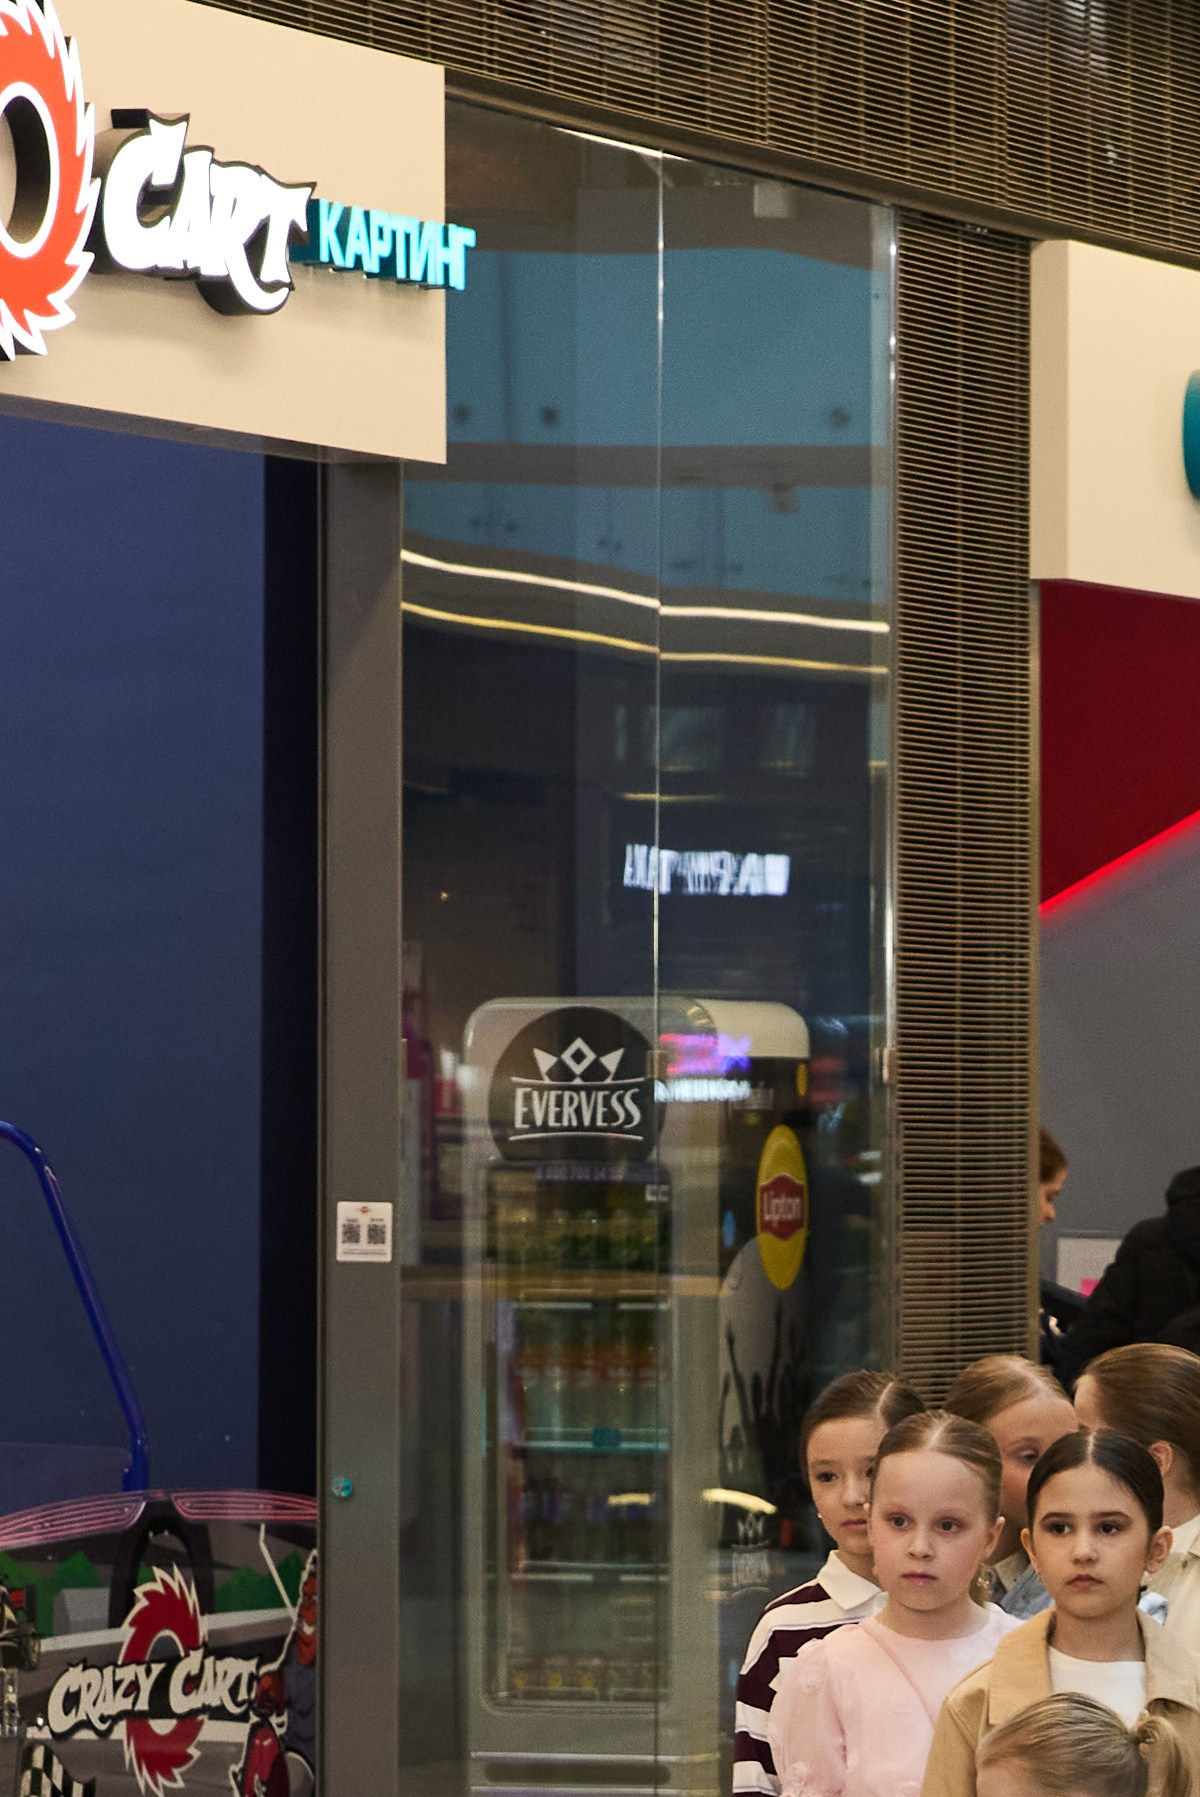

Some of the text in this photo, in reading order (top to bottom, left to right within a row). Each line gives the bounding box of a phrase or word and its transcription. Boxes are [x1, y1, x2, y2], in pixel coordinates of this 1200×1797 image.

[318, 198, 478, 291] КАРТИНГ
[513, 1087, 643, 1130] EVERVESS
[763, 1190, 802, 1223] Lipton
[48, 1648, 259, 1736] CRAZY CART
